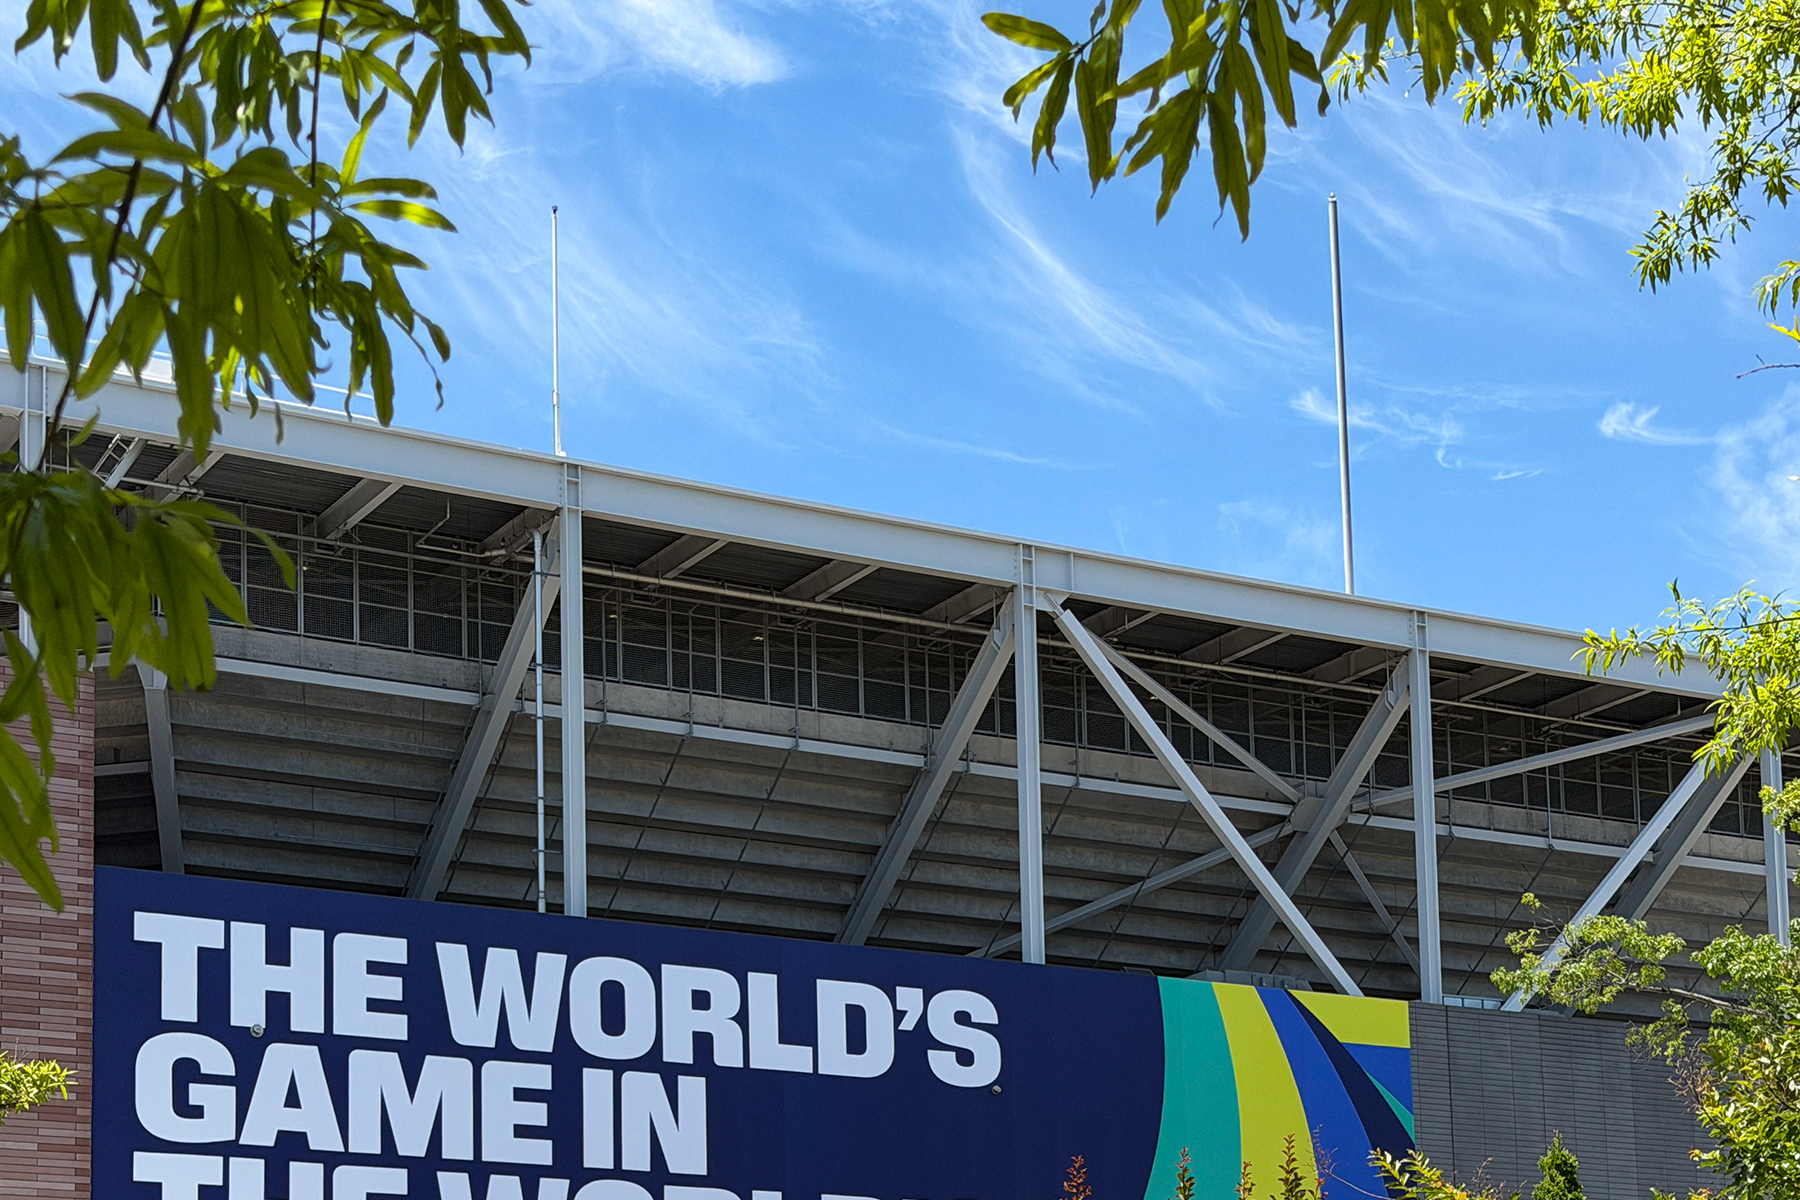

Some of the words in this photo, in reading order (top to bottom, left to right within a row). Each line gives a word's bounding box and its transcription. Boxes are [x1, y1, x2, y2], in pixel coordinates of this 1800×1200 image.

[134, 911, 408, 1040] THE
[435, 942, 1002, 1087] WORLD’S
[135, 1032, 552, 1165] GAME
[583, 1068, 707, 1176] IN
